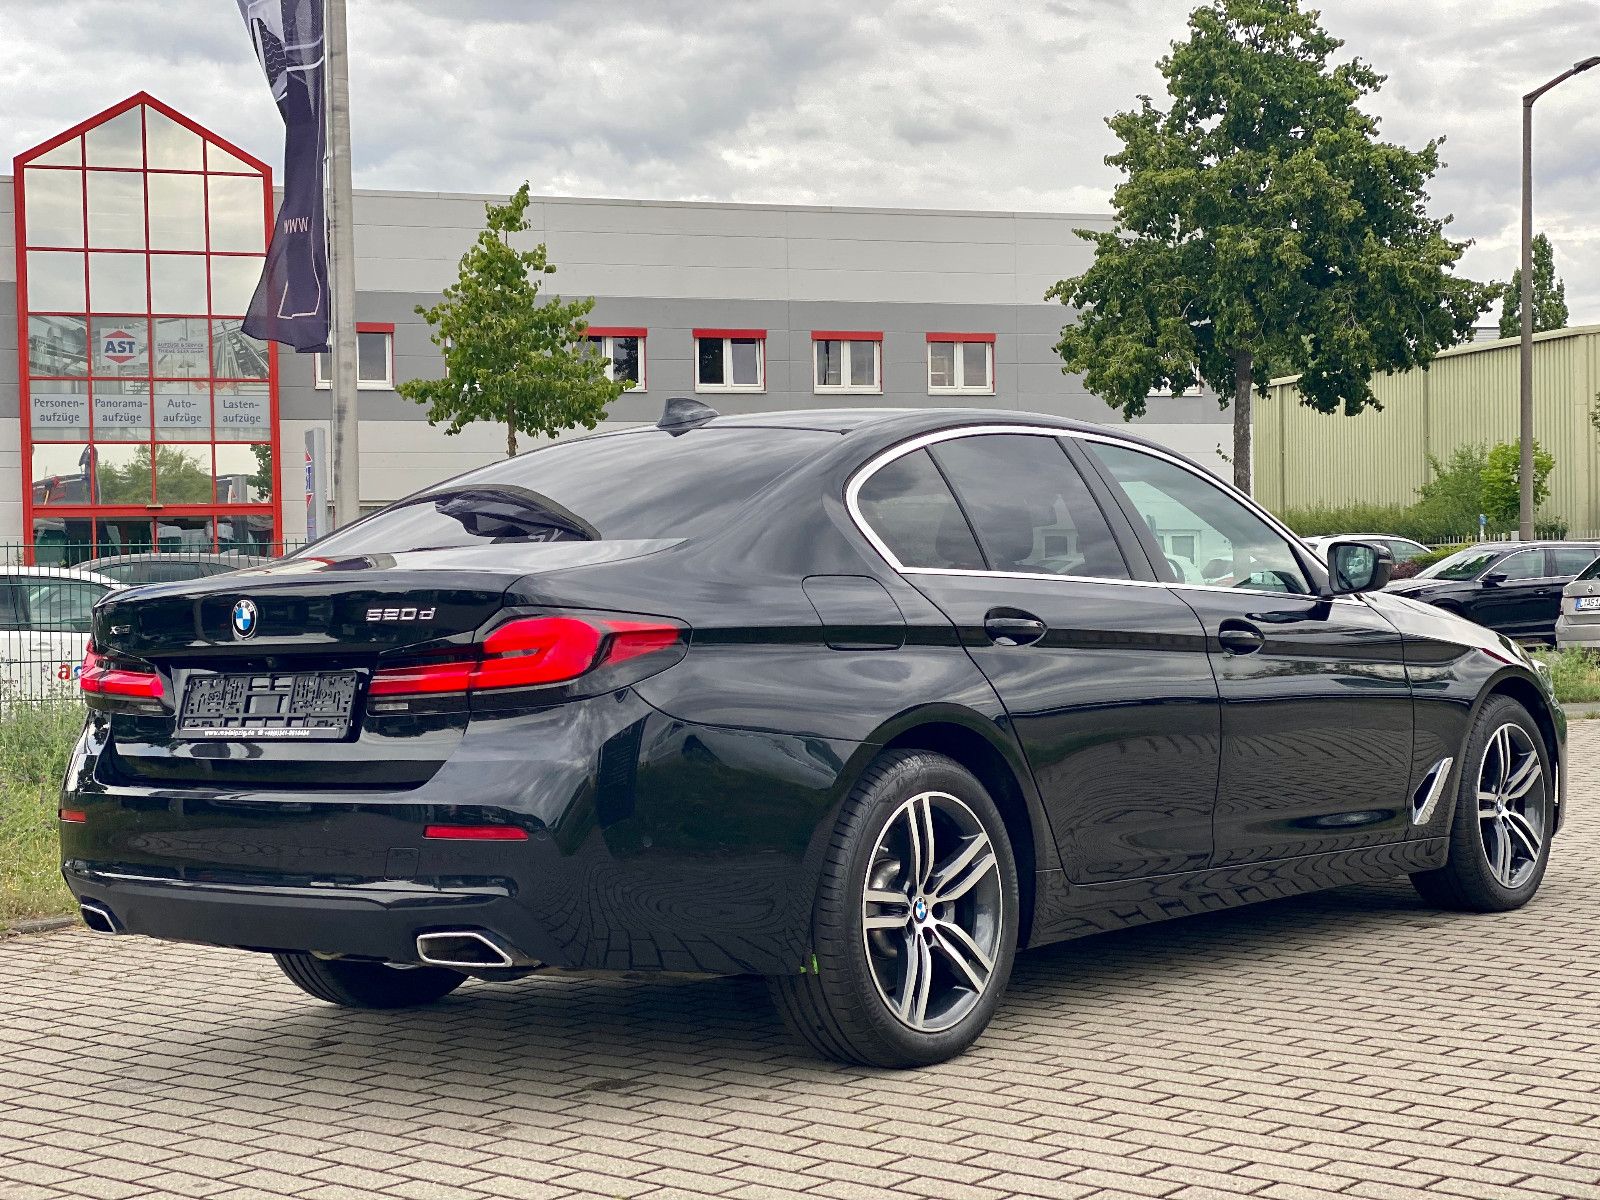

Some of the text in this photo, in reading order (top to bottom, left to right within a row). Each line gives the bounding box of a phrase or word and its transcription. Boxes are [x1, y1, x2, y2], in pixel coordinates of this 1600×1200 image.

[104, 340, 136, 354] AST
[34, 398, 85, 408] Personen-
[94, 398, 148, 408] Panorama-
[167, 398, 197, 408] Auto-
[223, 399, 260, 409] Lasten-
[39, 412, 80, 423] aufzüge
[102, 412, 142, 424] aufzüge
[163, 412, 202, 424] aufzüge
[222, 413, 261, 425] aufzüge
[366, 607, 436, 621] 520d
